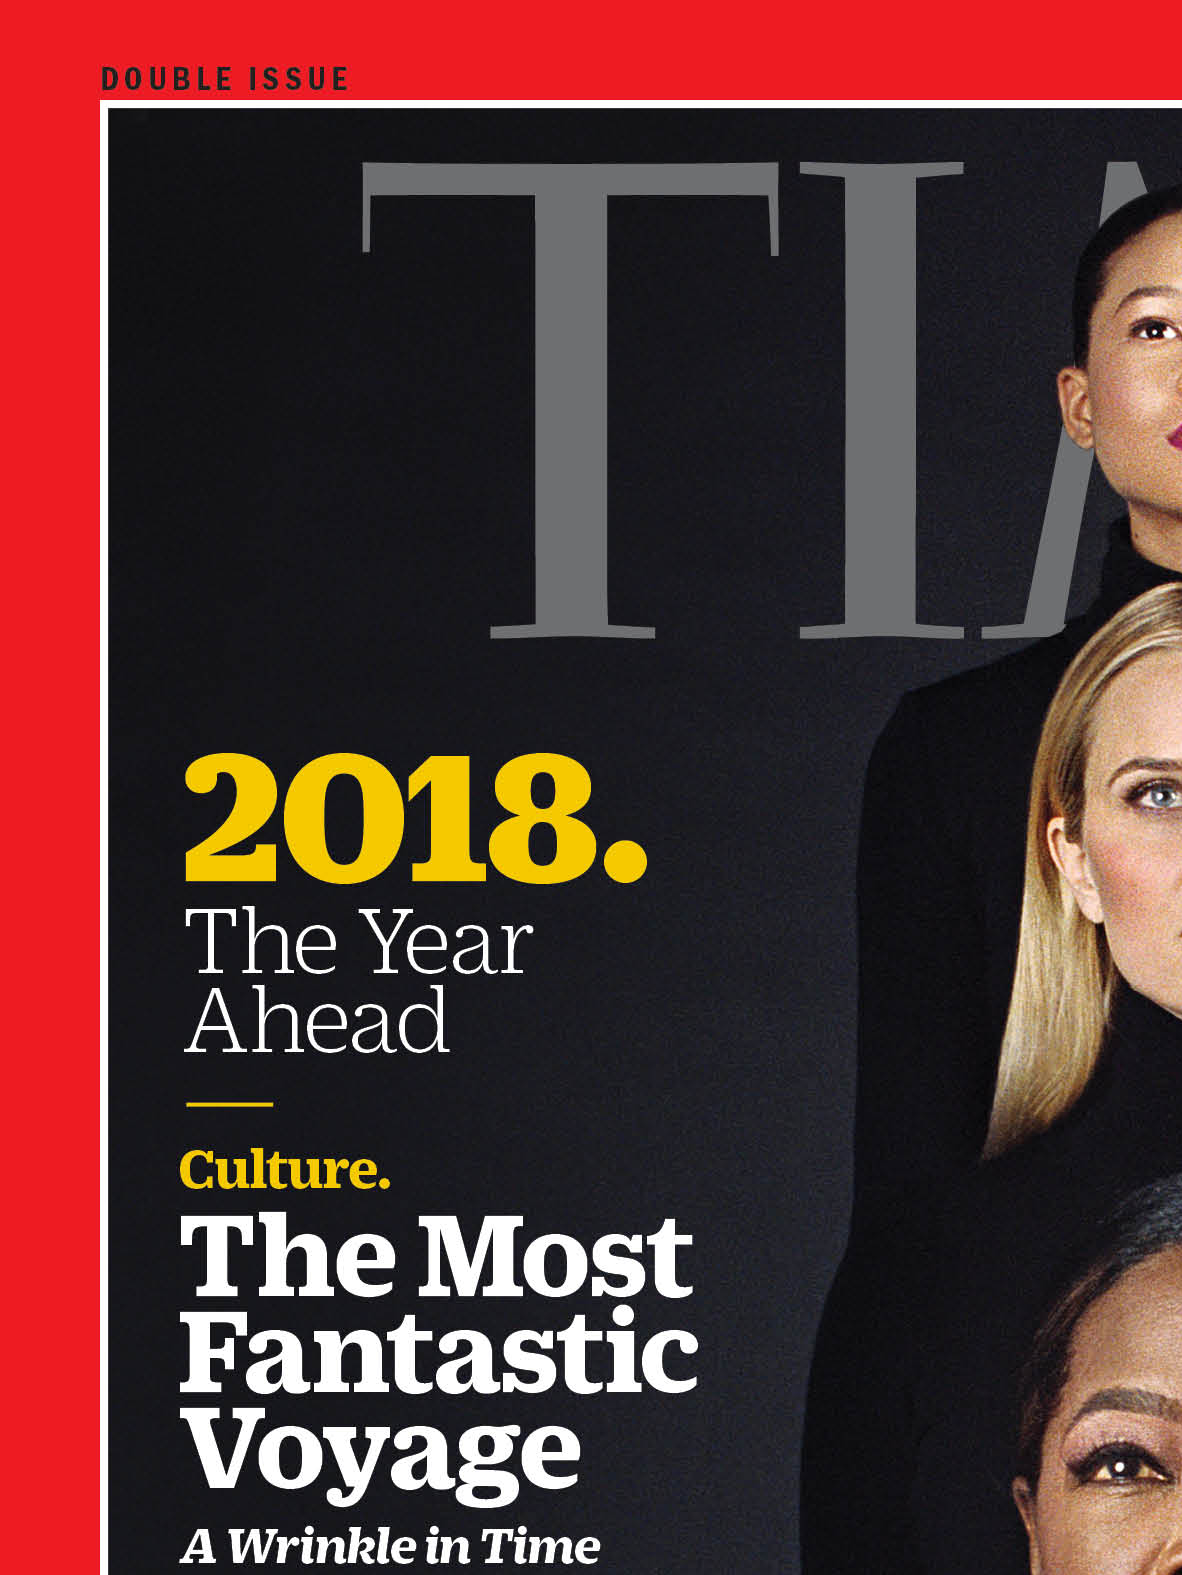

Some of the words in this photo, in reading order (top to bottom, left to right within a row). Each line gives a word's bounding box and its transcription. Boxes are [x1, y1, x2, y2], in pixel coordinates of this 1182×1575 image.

[101, 66, 232, 91] DOUBLE
[249, 66, 348, 91] ISSUE
[184, 752, 648, 885] 2018.
[185, 905, 337, 975] The
[358, 908, 534, 975] Year
[183, 984, 451, 1054] Ahead
[179, 1147, 391, 1190] Culture.
[180, 1211, 396, 1298] The
[418, 1215, 694, 1299] Most
[179, 1304, 699, 1395] Fantastic
[179, 1407, 581, 1509] Voyage
[178, 1528, 217, 1564] A
[227, 1525, 417, 1565] Wrinkle
[425, 1525, 471, 1565] in
[481, 1525, 601, 1565] Time
